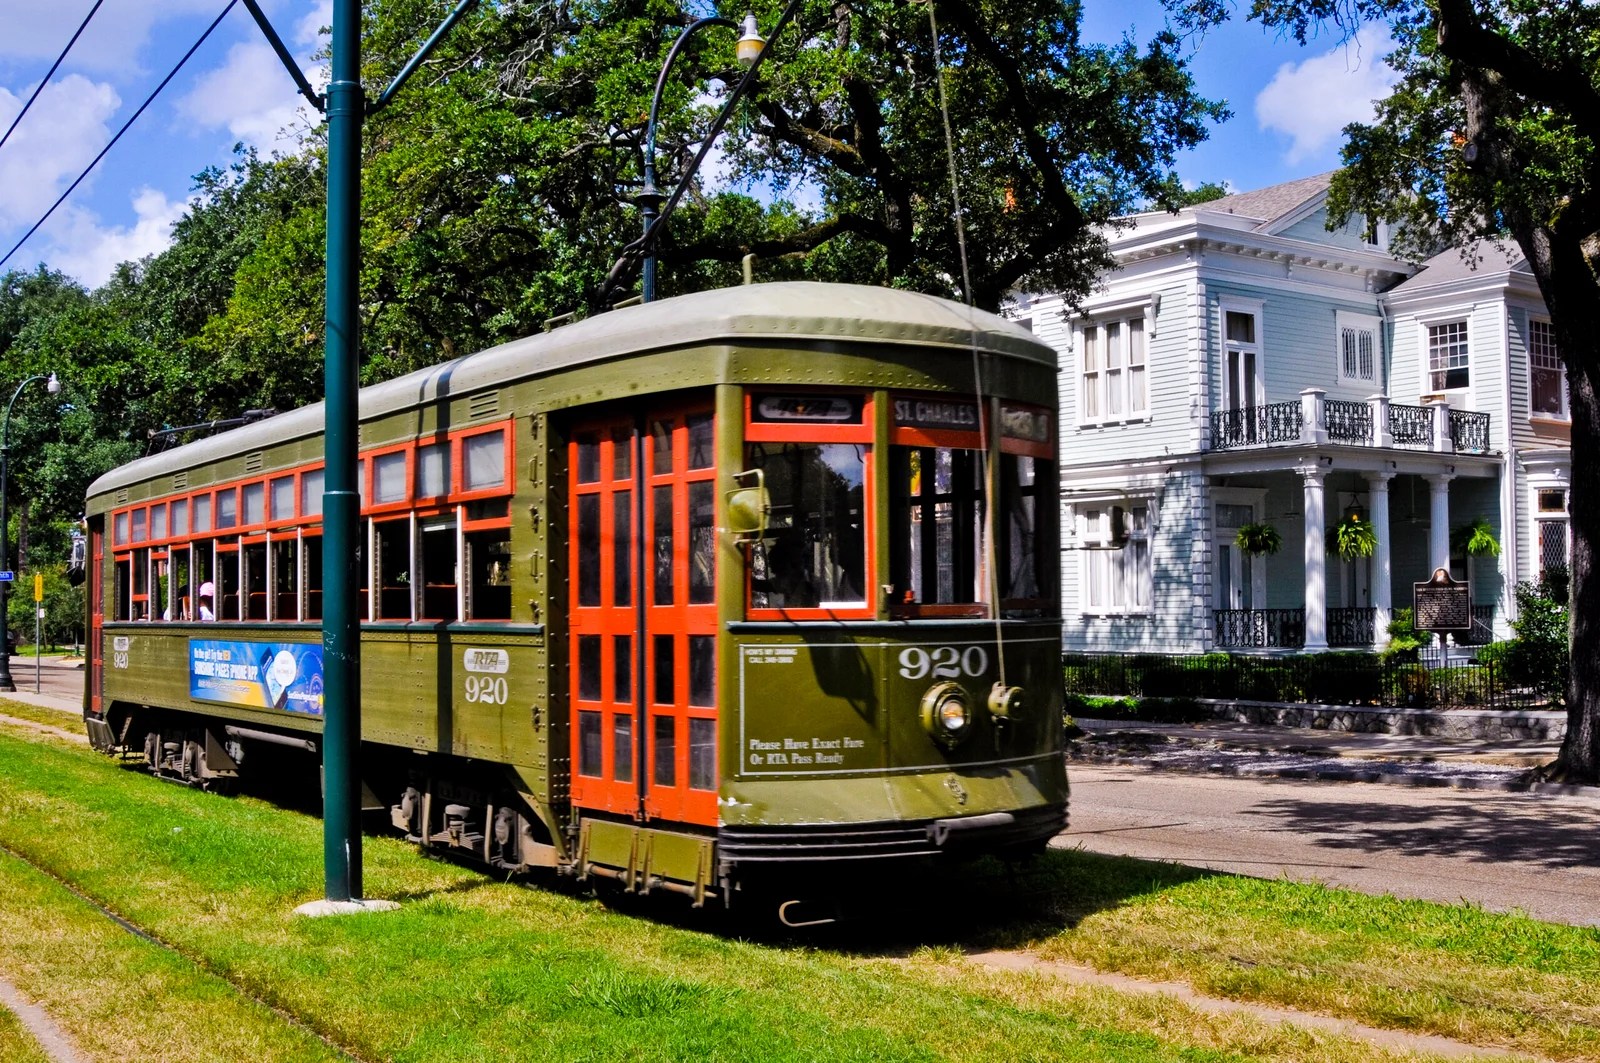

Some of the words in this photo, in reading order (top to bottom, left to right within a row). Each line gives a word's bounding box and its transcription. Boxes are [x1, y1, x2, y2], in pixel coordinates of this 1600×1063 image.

[916, 401, 976, 425] CHARLES
[113, 652, 129, 669] 920
[474, 651, 499, 666] RTA
[899, 646, 988, 680] 920
[465, 675, 508, 705] 920
[749, 739, 781, 750] Please
[784, 738, 809, 749] Have
[812, 738, 841, 749] Exact
[843, 737, 865, 748] Fare
[749, 753, 764, 765] Or
[767, 753, 788, 765] RTA
[791, 753, 813, 764] Pass
[815, 752, 844, 765] Ready
